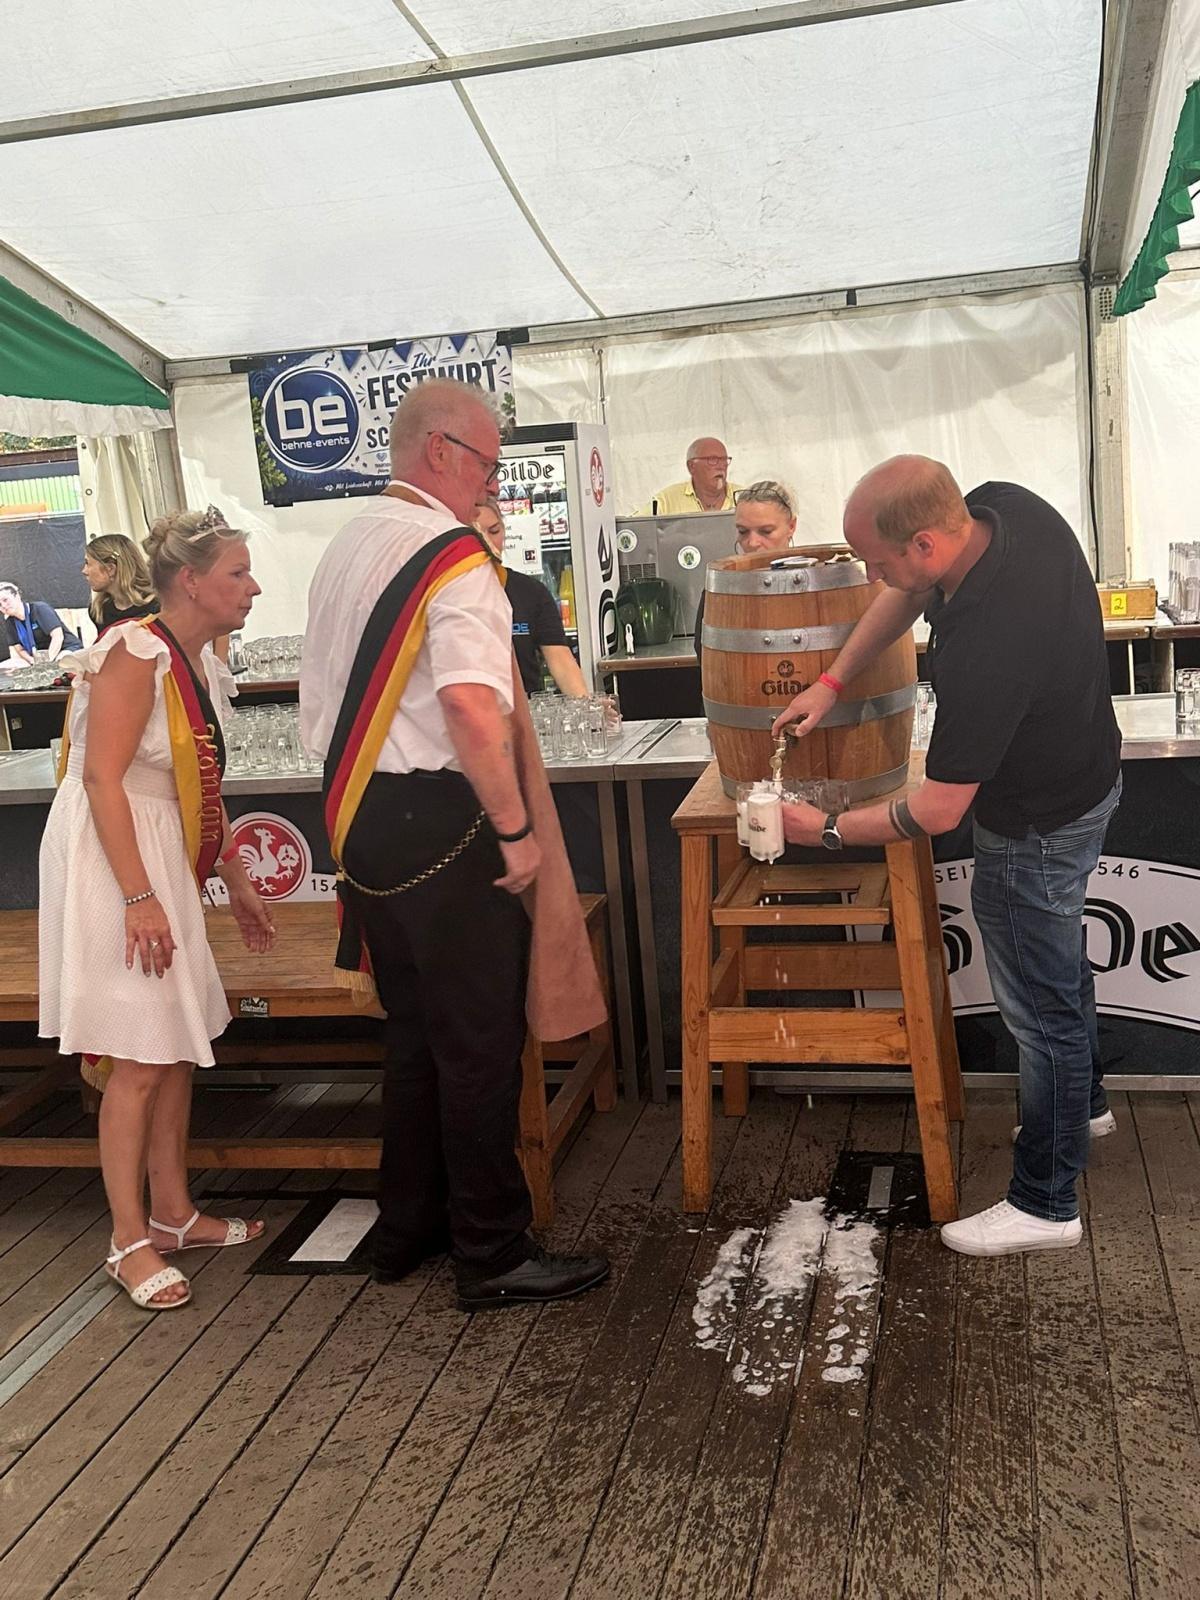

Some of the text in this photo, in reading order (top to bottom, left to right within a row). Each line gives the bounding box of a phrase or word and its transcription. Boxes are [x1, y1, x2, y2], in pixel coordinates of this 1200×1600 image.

[411, 352, 436, 369] Ihr
[275, 382, 349, 440] be
[1114, 597, 1124, 610] 2
[935, 861, 1140, 883] SEI 546
[201, 883, 226, 898] eit
